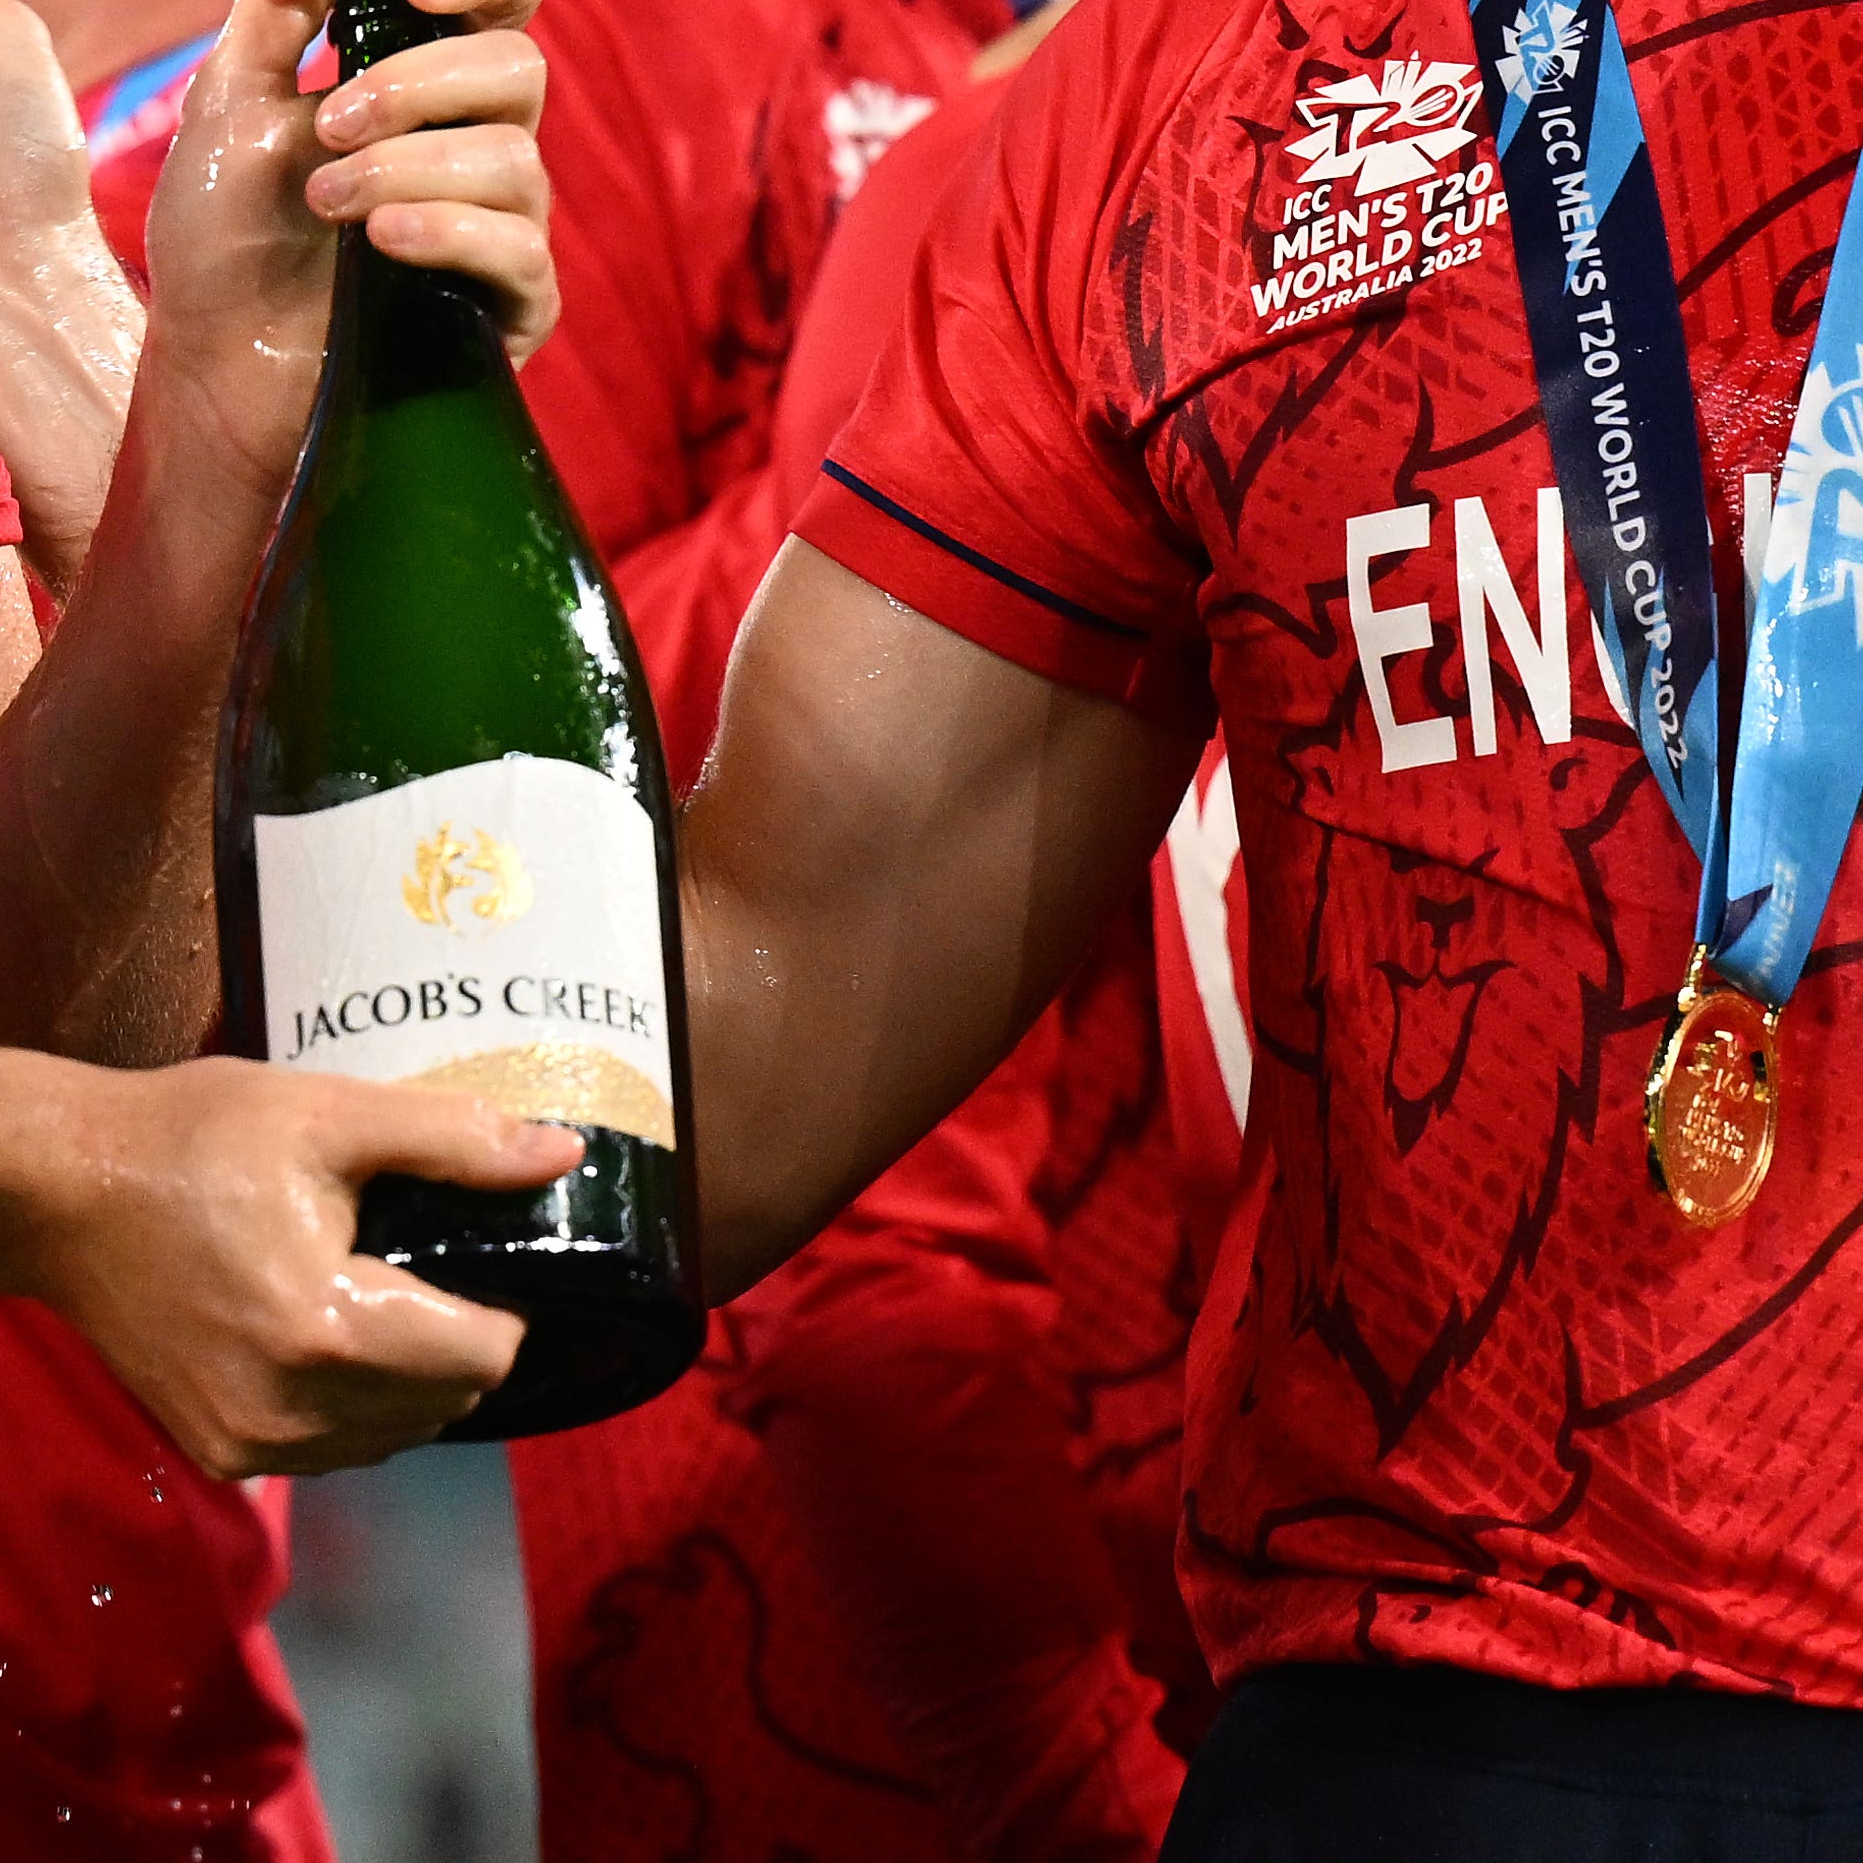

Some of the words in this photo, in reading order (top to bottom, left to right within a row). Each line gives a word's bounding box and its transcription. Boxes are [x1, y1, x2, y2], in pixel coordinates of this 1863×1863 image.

[1537, 106, 1582, 166] ICC
[1273, 192, 1408, 270] MEN'S
[1416, 162, 1494, 214] T20
[1282, 184, 1333, 225] ICC
[1552, 169, 1608, 297] MEN'S
[1250, 229, 1413, 317] WORLD
[1421, 191, 1508, 247] CUP
[1266, 265, 1413, 334] AUSTRALIA
[1419, 237, 1483, 278] 2022
[1577, 300, 1620, 378] T20
[1590, 383, 1647, 553] WORLD
[1625, 561, 1672, 651] CUP
[1650, 658, 1689, 769] 2022
[286, 973, 483, 1060] JACOB'S
[503, 975, 657, 1040] CREEK
